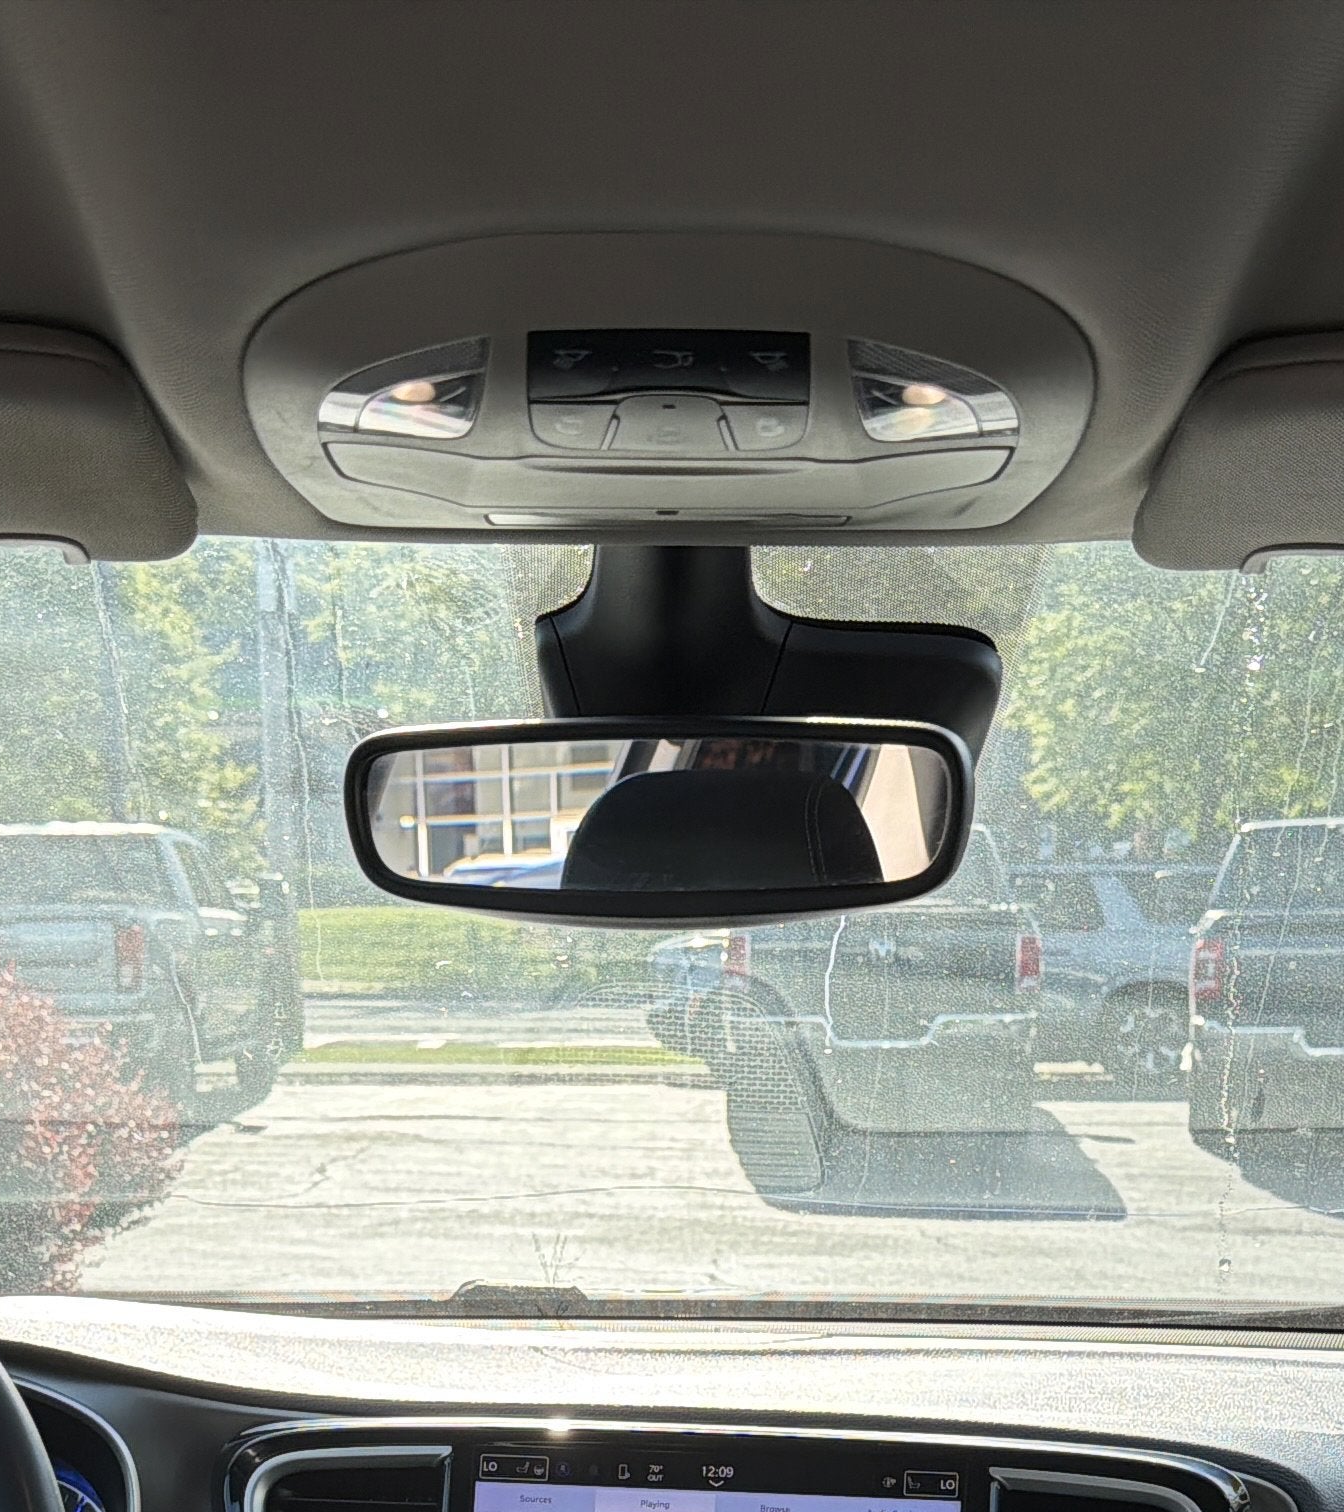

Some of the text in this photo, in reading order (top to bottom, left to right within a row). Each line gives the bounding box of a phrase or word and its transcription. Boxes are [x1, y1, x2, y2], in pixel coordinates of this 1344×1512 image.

[483, 1461, 498, 1472] LO
[702, 1465, 734, 1478] 12:09
[647, 1473, 663, 1482] OUT
[940, 1479, 955, 1490] LO
[519, 1494, 552, 1505] Sources
[640, 1499, 670, 1510] Playing
